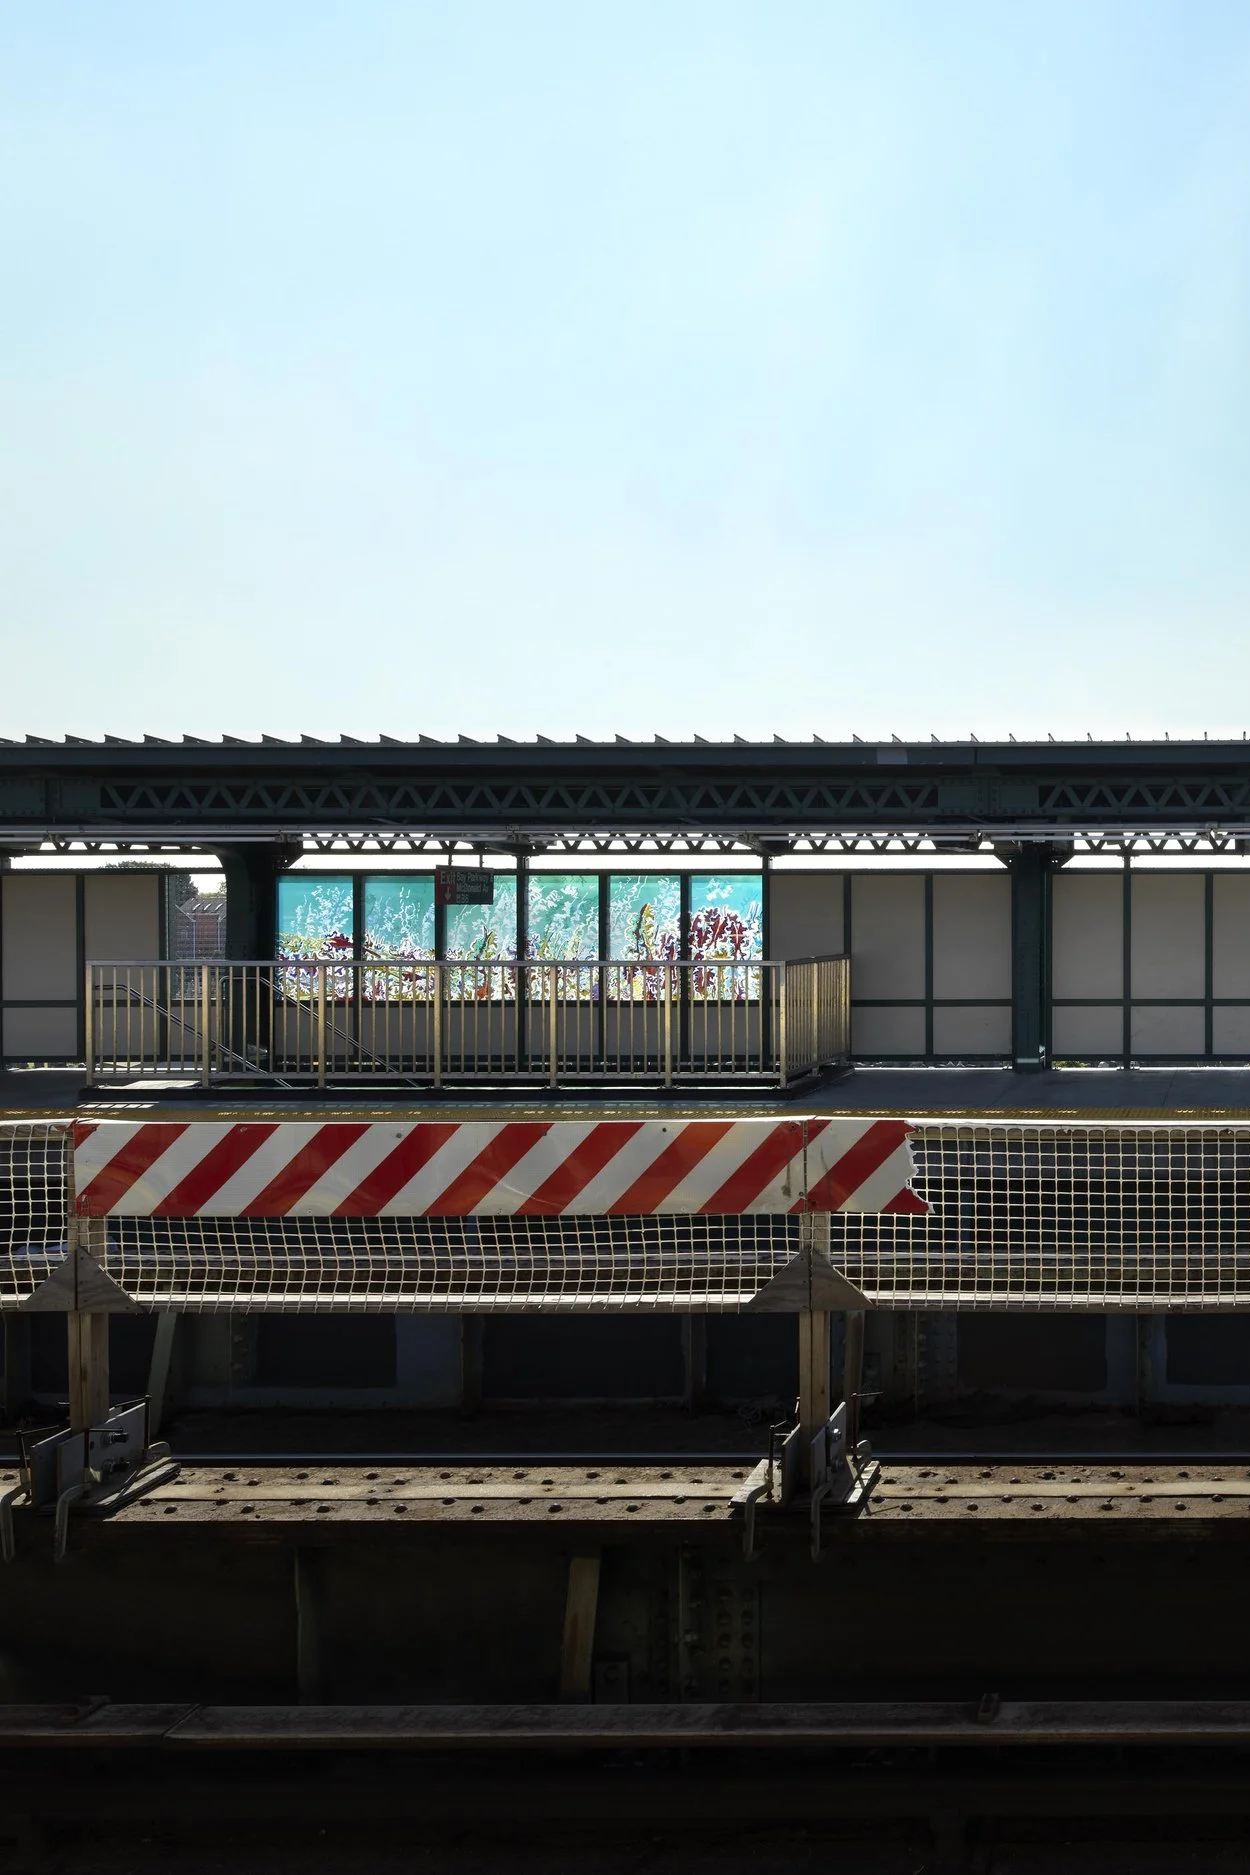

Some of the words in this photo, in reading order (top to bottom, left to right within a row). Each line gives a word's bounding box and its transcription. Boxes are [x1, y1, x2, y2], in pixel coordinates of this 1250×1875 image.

[441, 871, 456, 884] Exit
[457, 872, 466, 882] Bay
[468, 872, 489, 883] Parkway
